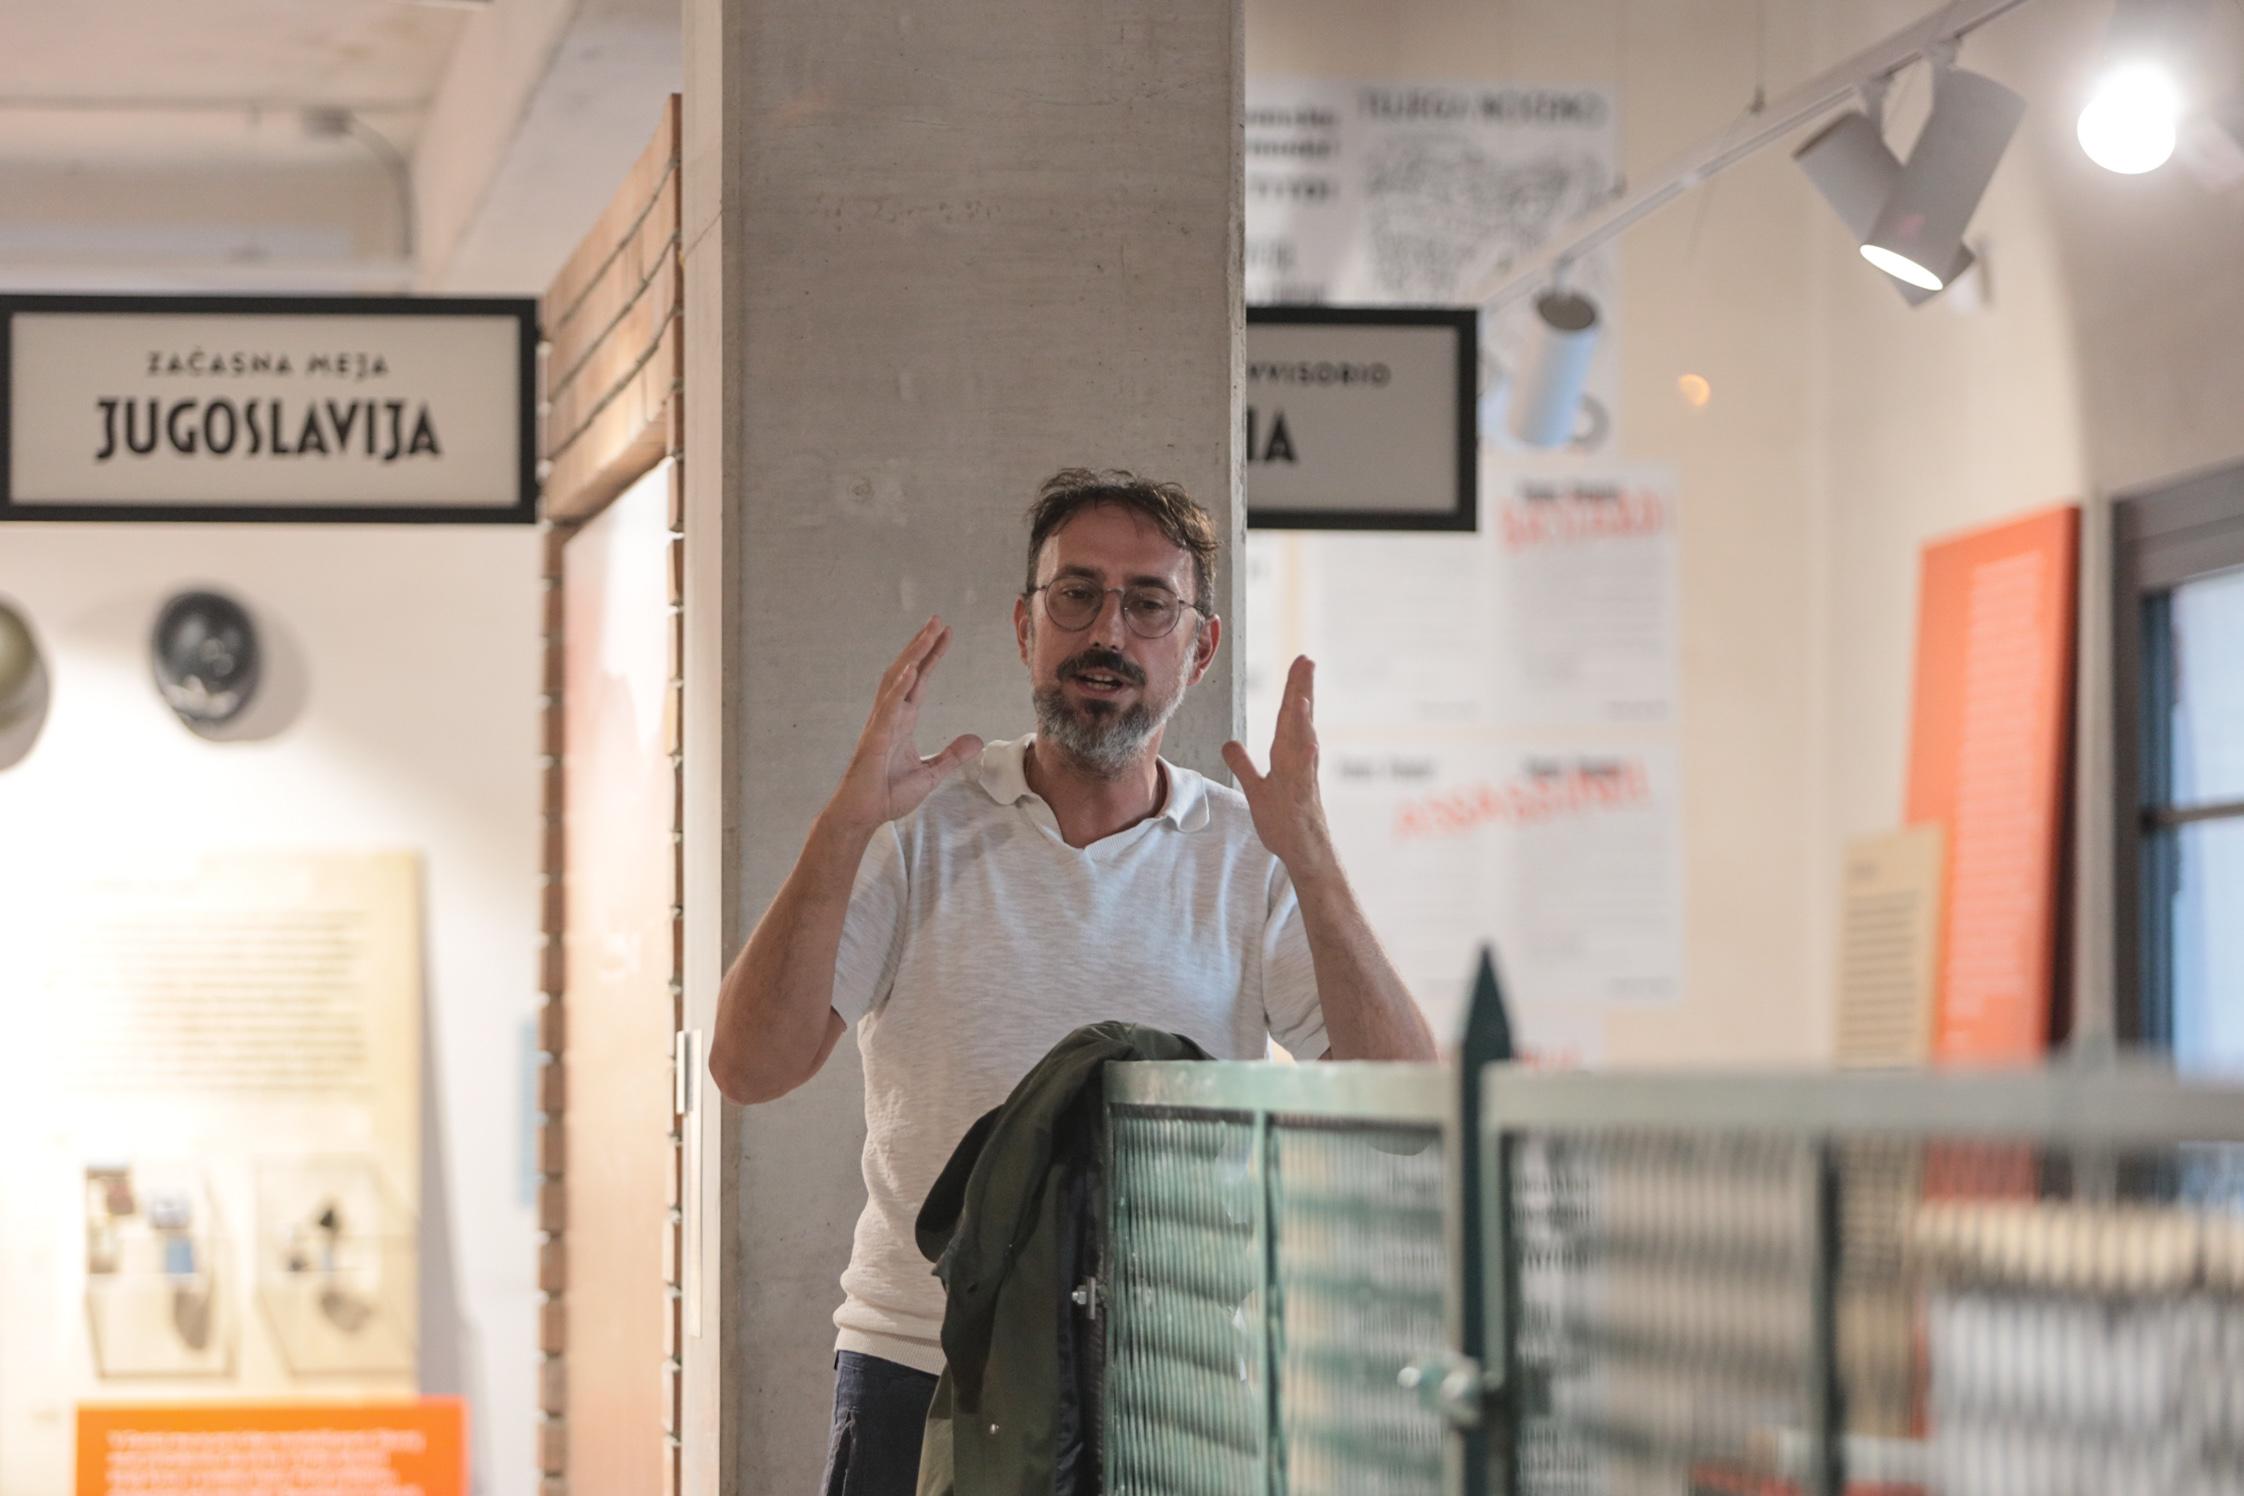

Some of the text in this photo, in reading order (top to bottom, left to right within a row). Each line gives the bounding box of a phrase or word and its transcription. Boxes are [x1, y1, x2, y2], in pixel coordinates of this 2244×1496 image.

[147, 347, 389, 382] ZAČASNA MEJA
[1247, 362, 1391, 388] VVISORIO
[96, 399, 441, 462] JUGOSLAVIJA
[1247, 408, 1296, 463] IA
